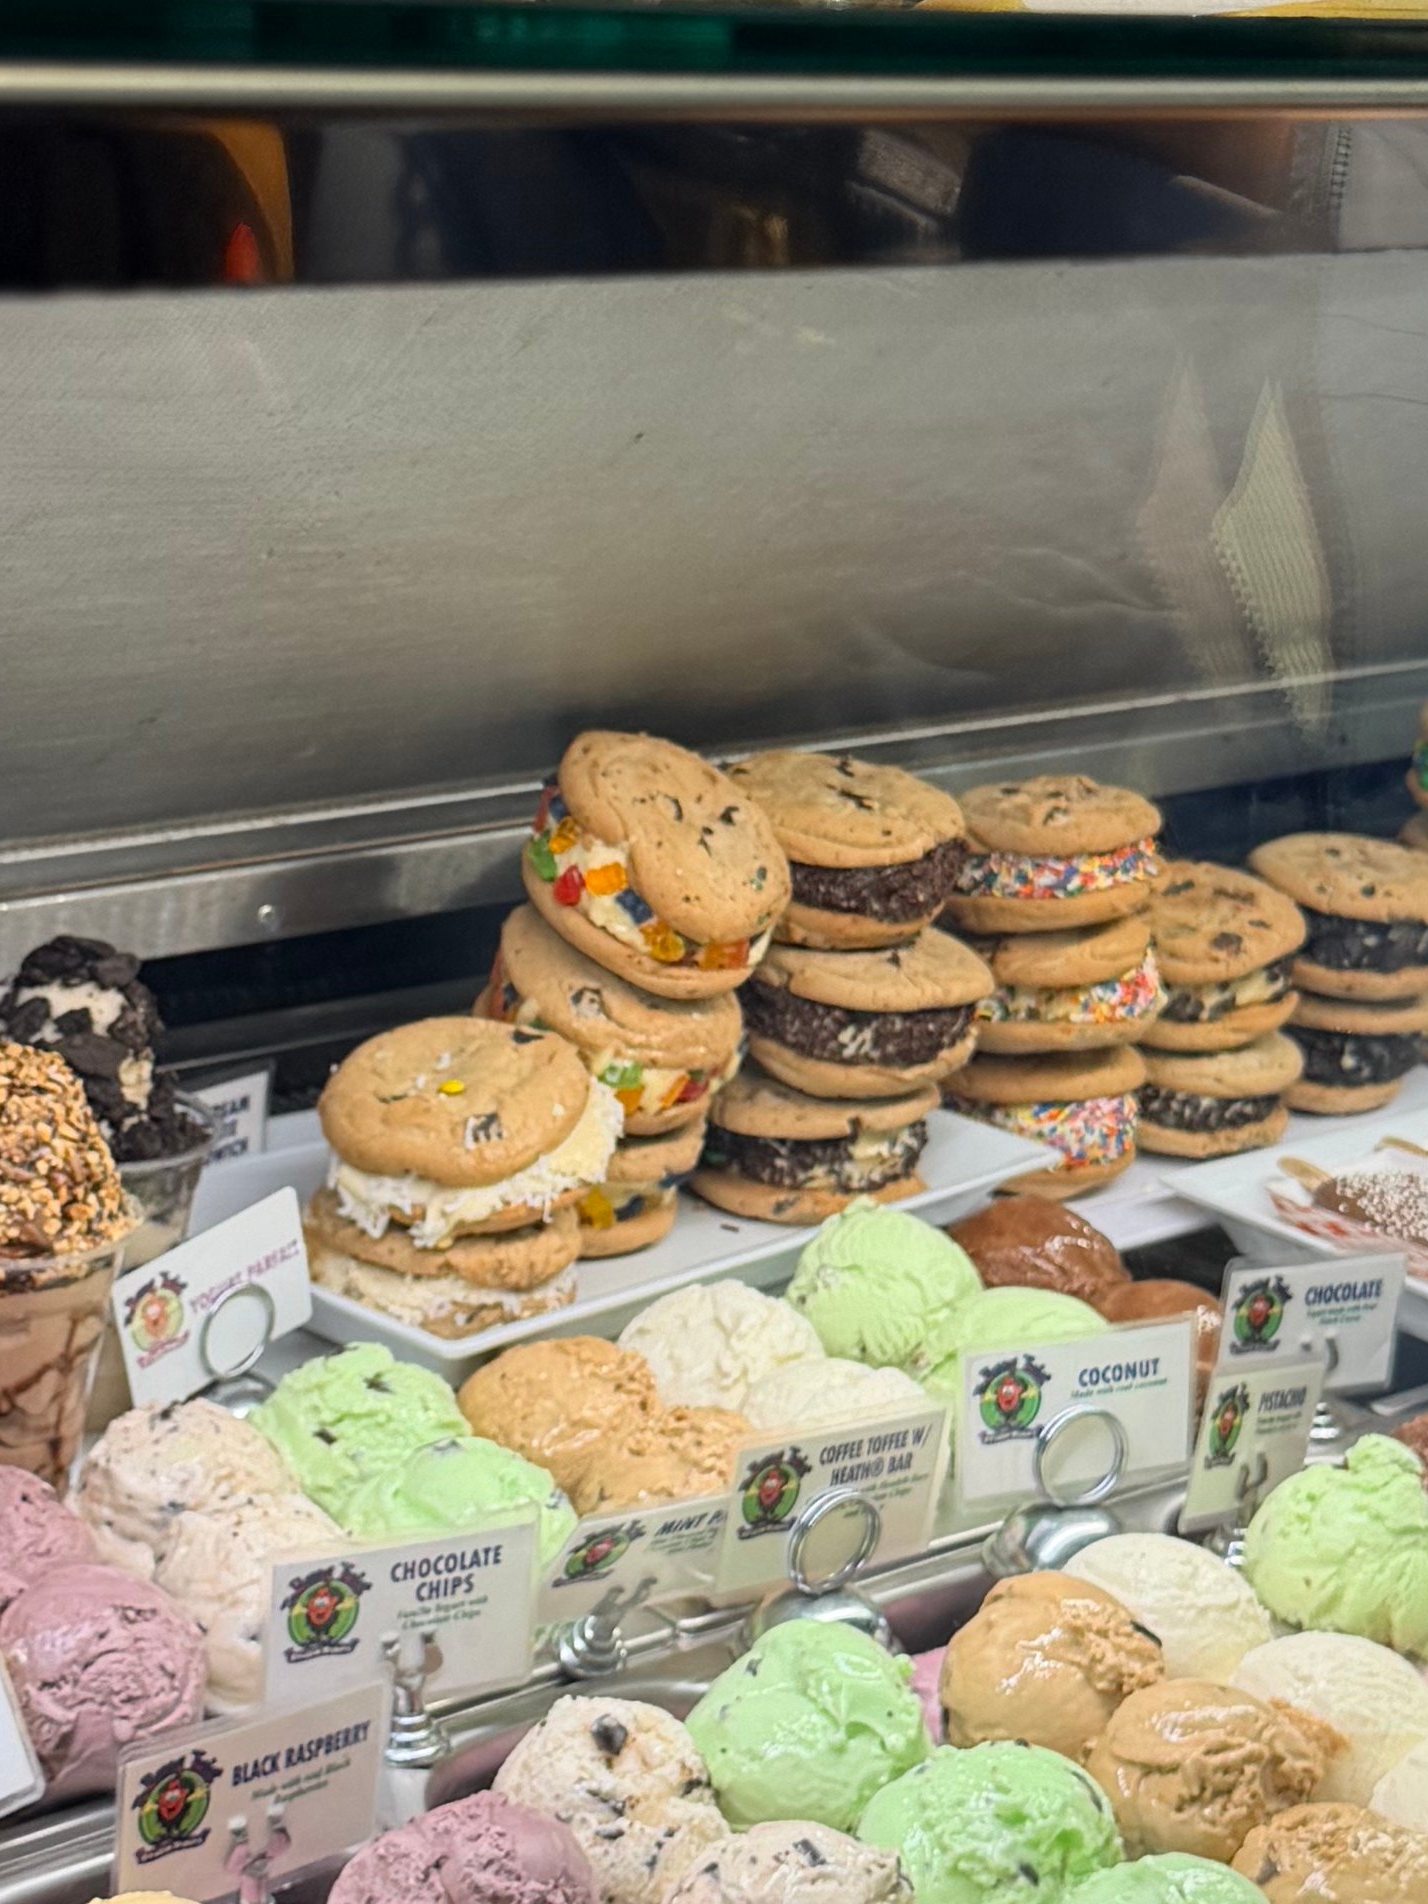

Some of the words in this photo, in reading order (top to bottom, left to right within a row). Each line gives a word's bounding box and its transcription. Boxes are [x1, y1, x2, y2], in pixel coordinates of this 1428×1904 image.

[1304, 1276, 1384, 1307] CHOCOLATE
[1078, 1357, 1160, 1387] COCONUT
[820, 1439, 863, 1466] COFFEE
[868, 1430, 907, 1458] TOFFEE
[913, 1423, 932, 1450] W/
[887, 1451, 913, 1473] BAR
[390, 1544, 502, 1583] CHOCOLATE
[415, 1573, 474, 1603] CHIPS
[231, 1752, 280, 1786] BLACK
[285, 1720, 371, 1770] RASPBERRY
